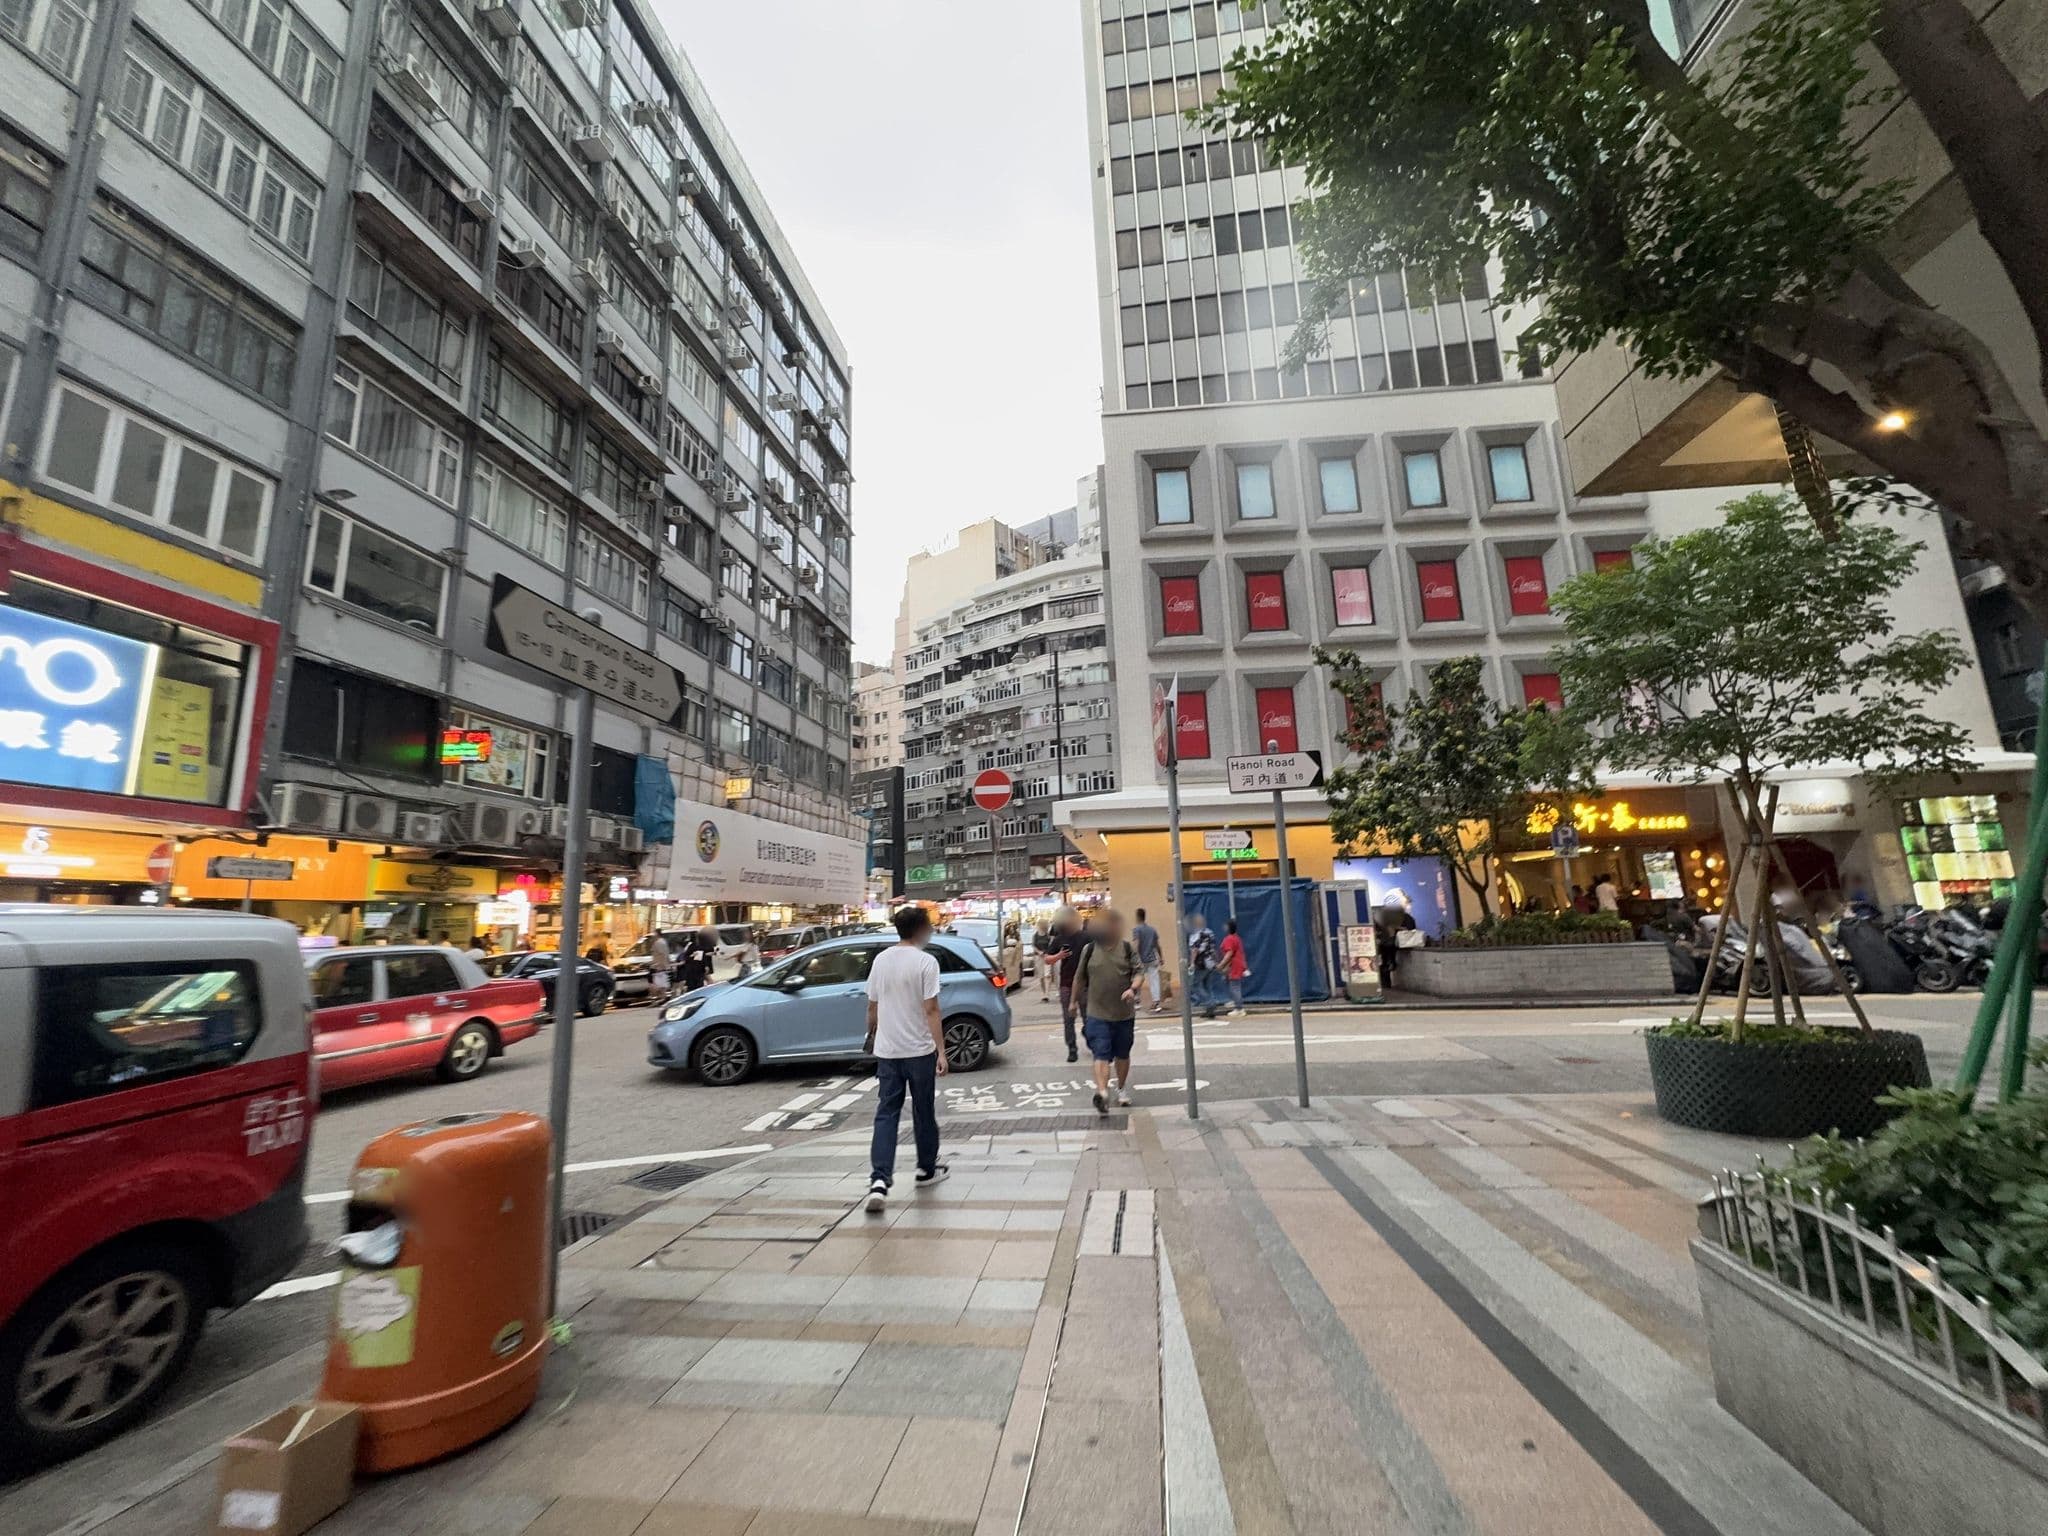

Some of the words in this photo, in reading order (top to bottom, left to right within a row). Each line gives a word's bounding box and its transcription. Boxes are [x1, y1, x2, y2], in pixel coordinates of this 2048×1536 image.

[543, 610, 620, 661] Carnarvon
[623, 651, 655, 679] Road
[1231, 760, 1263, 770] Hanoi
[1267, 758, 1295, 768] Road
[1242, 772, 1288, 786] 河內道
[1294, 773, 1304, 781] 18
[240, 1116, 305, 1157] TAXI
